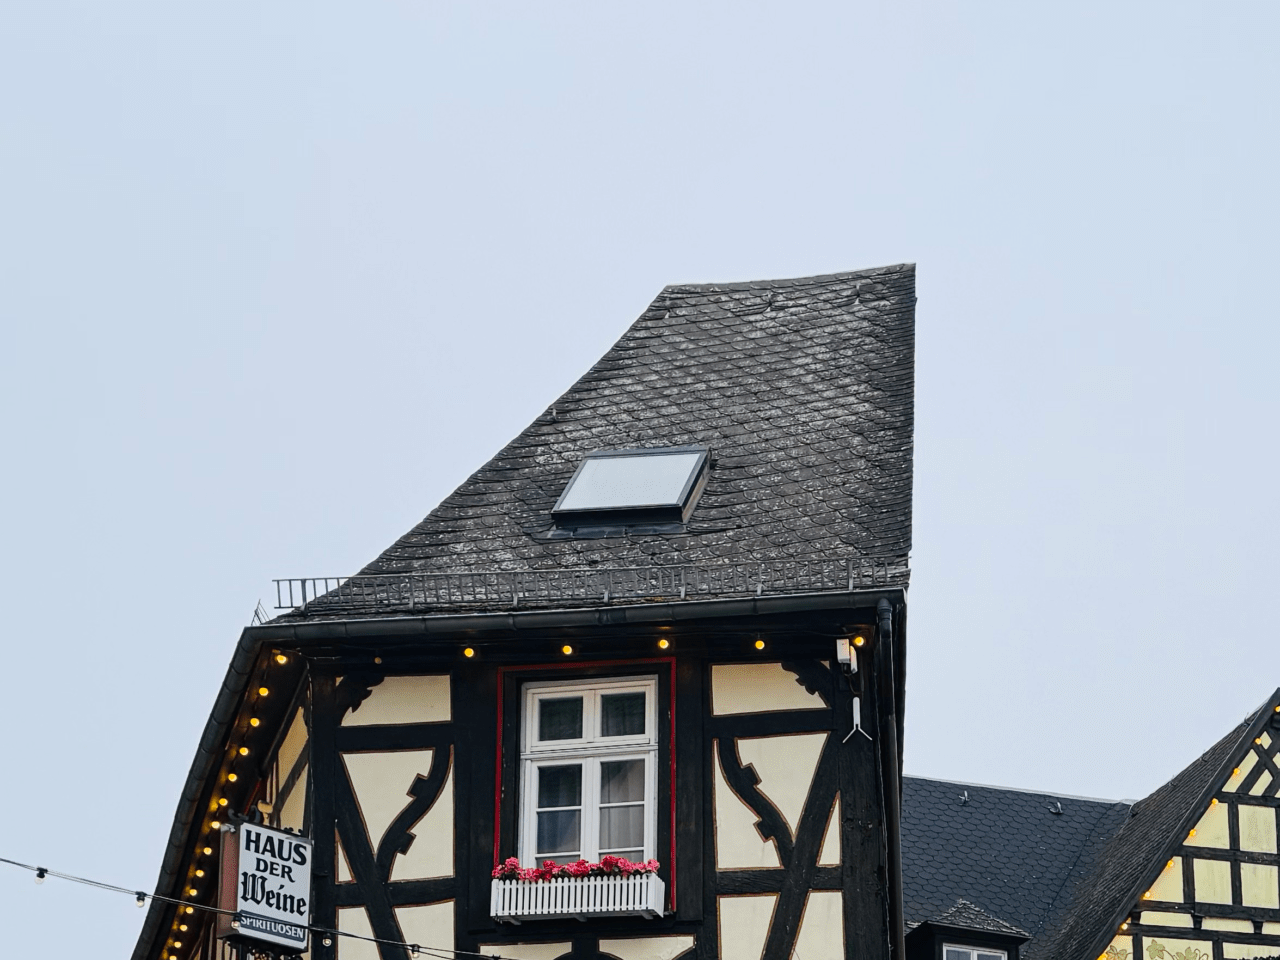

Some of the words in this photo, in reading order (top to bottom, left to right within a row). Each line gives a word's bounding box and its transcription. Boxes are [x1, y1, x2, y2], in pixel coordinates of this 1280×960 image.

[245, 829, 307, 866] HAUS
[255, 857, 296, 883] DER
[240, 871, 307, 917] Weine
[240, 916, 305, 939] SPIRITUOSEN
